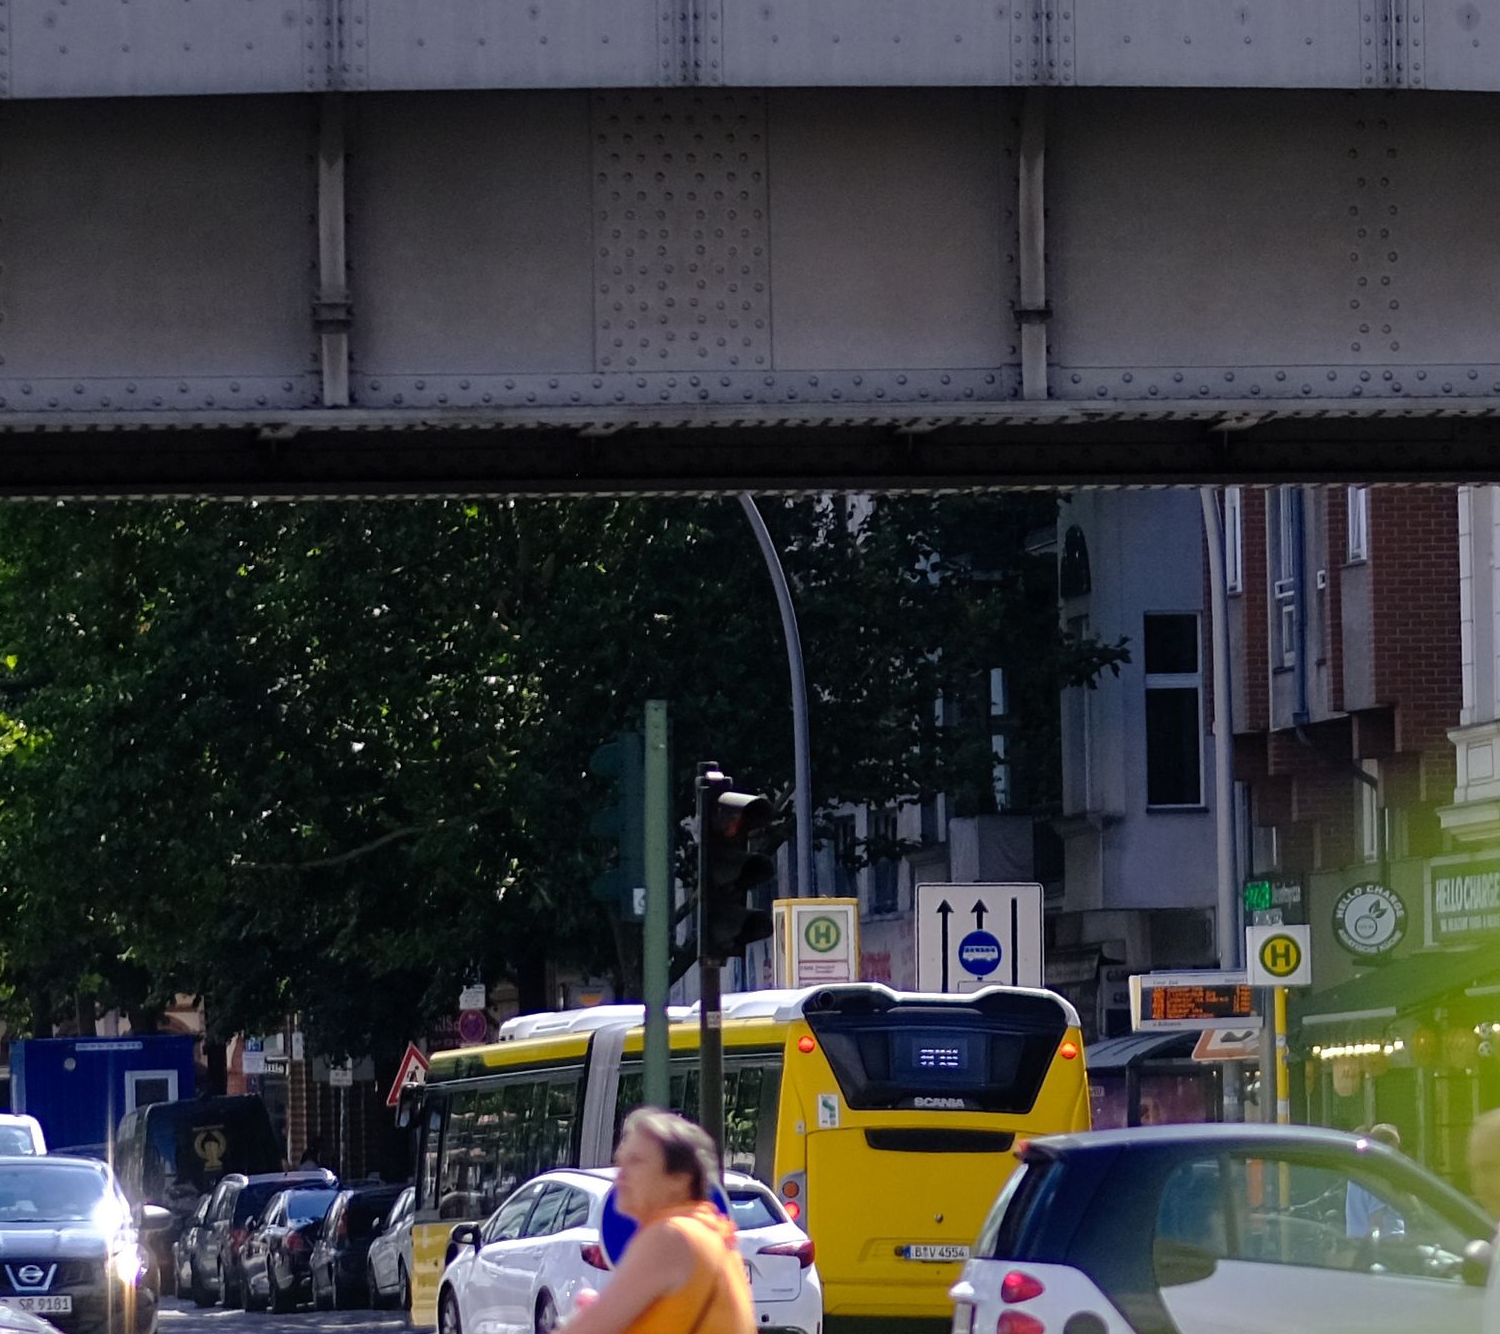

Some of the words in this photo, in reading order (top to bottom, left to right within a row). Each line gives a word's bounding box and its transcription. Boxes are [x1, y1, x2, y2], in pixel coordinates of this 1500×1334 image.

[1436, 876, 1463, 915] HELLO
[914, 1097, 965, 1108] SCANIA
[38, 1296, 70, 1311] 9181
